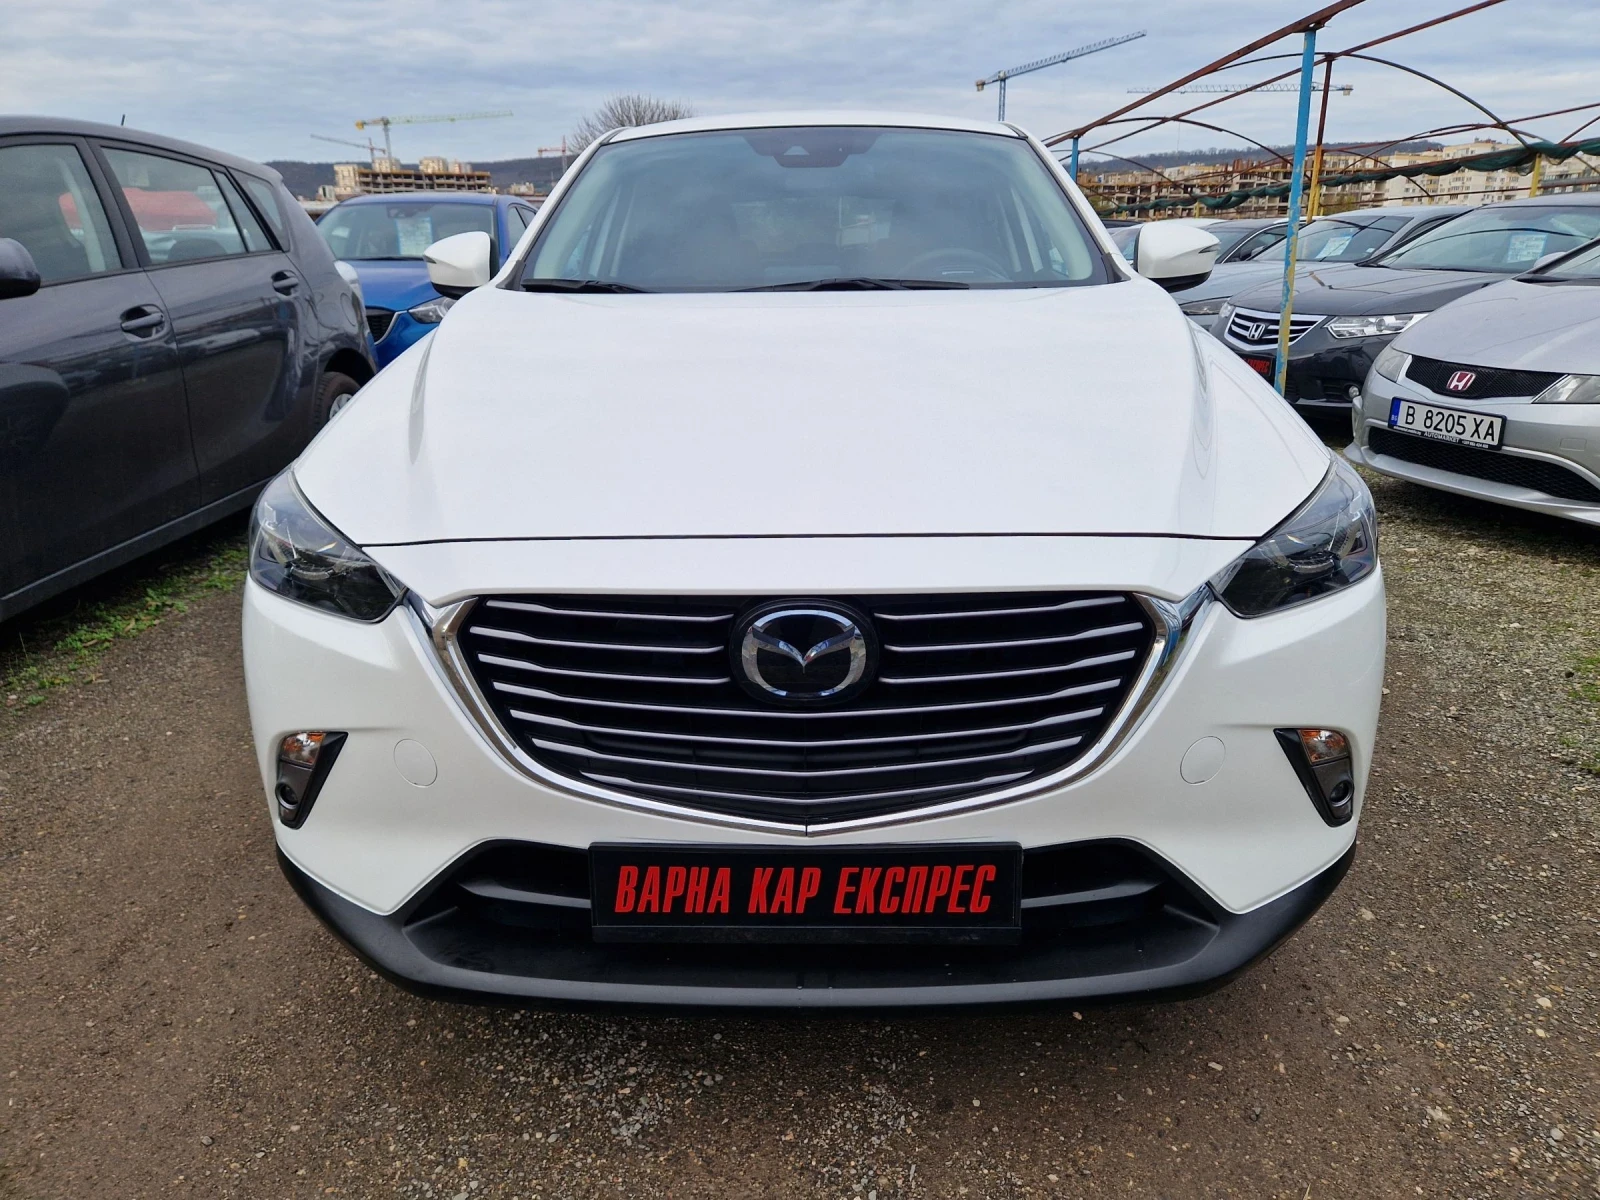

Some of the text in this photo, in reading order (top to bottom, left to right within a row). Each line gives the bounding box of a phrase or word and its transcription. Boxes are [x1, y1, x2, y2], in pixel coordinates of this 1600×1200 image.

[1405, 405, 1416, 425] B
[1423, 409, 1467, 436] 8205
[1470, 417, 1495, 442] XA
[1423, 431, 1460, 443] AUTOMARKET
[614, 864, 997, 915] ВАРНА КАР ЕКСПРЕС
